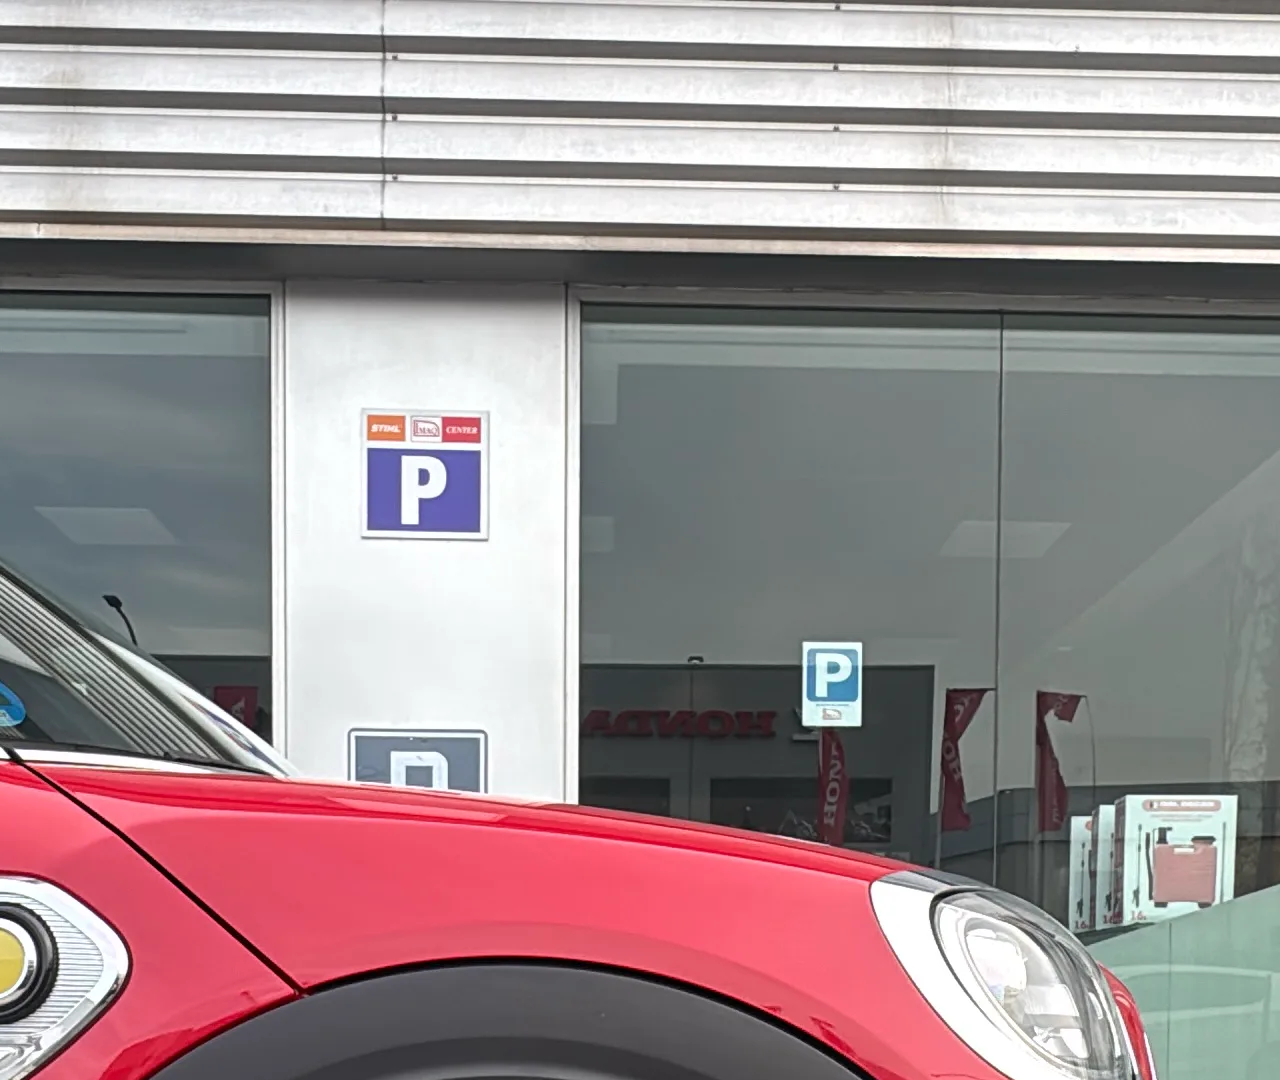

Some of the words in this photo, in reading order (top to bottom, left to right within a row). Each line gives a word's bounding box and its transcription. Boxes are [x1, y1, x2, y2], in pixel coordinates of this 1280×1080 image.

[371, 423, 401, 433] STIHL
[446, 426, 478, 435] CENTER
[400, 455, 447, 525] P
[815, 652, 853, 698] P
